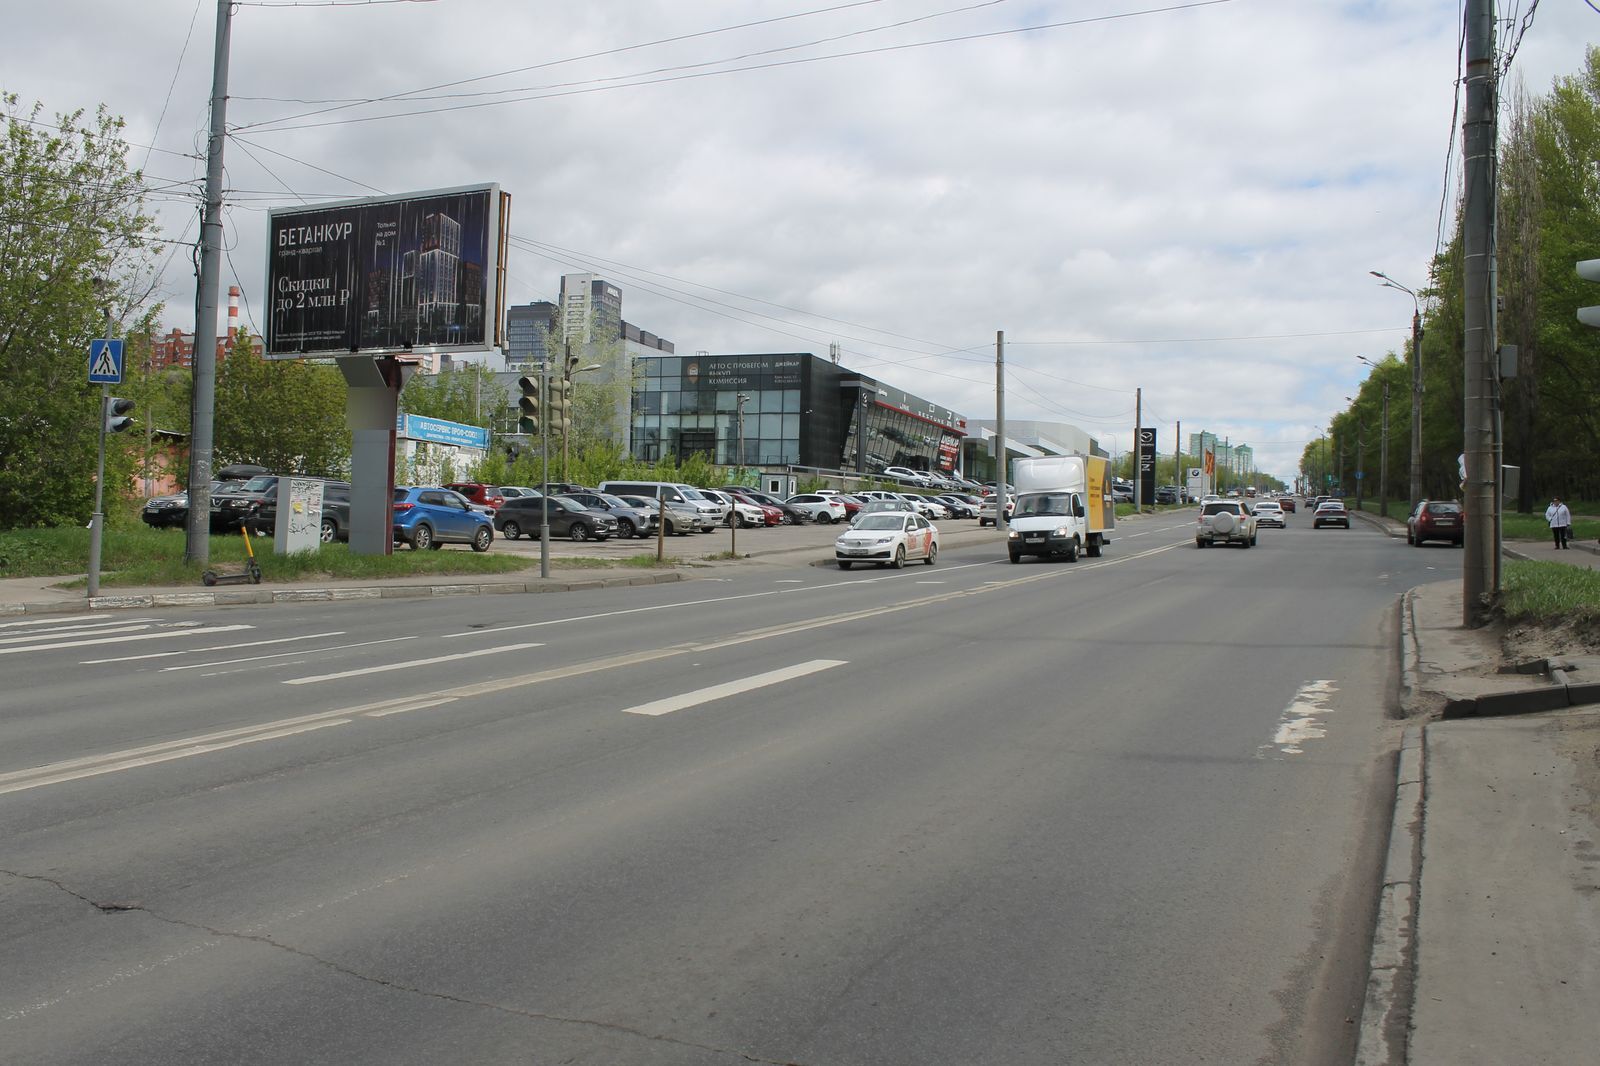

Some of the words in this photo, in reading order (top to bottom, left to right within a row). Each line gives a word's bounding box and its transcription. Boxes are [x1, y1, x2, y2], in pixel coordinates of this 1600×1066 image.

[279, 222, 352, 246] БЕТАНКУР
[278, 276, 330, 293] Скидки
[276, 298, 293, 312] до
[296, 292, 305, 308] 2
[308, 295, 336, 307] млн
